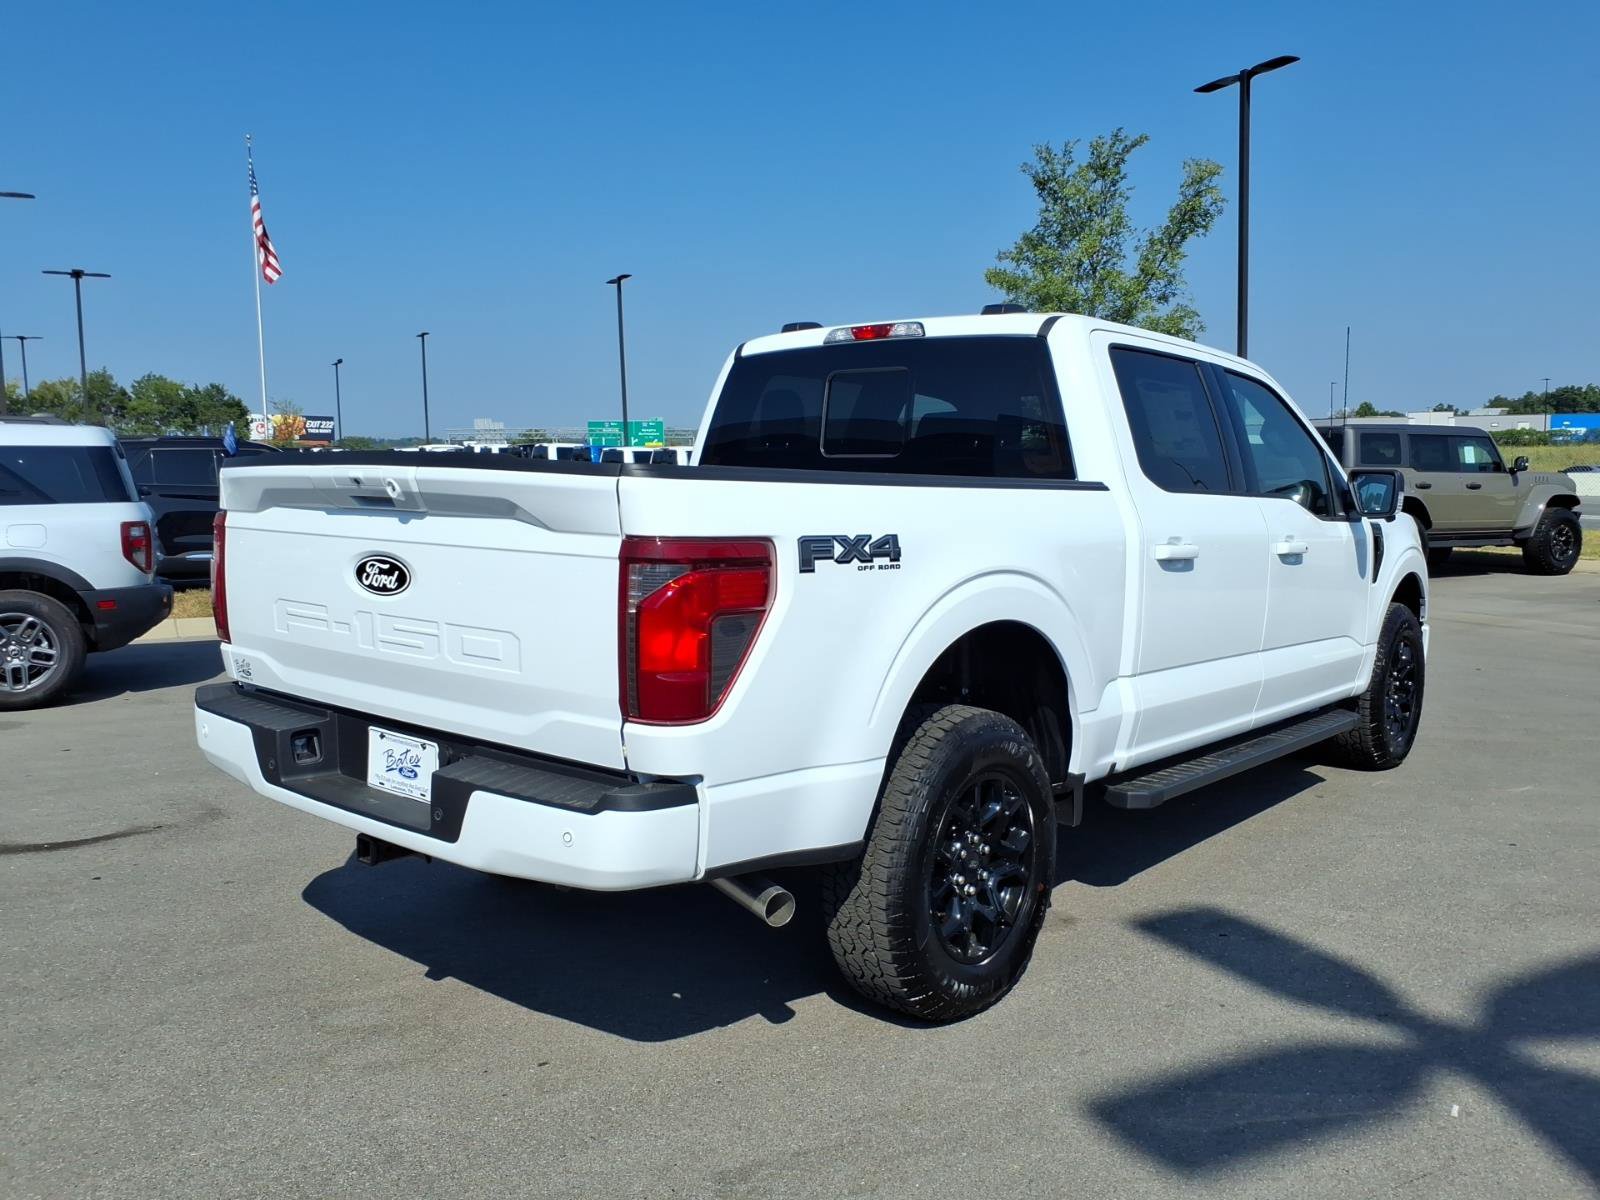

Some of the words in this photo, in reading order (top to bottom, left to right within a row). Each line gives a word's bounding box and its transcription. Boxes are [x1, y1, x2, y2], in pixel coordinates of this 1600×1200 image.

[797, 534, 901, 573] FX4
[362, 561, 399, 589] Ford
[274, 598, 522, 674] F-150
[383, 748, 421, 769] Bates
